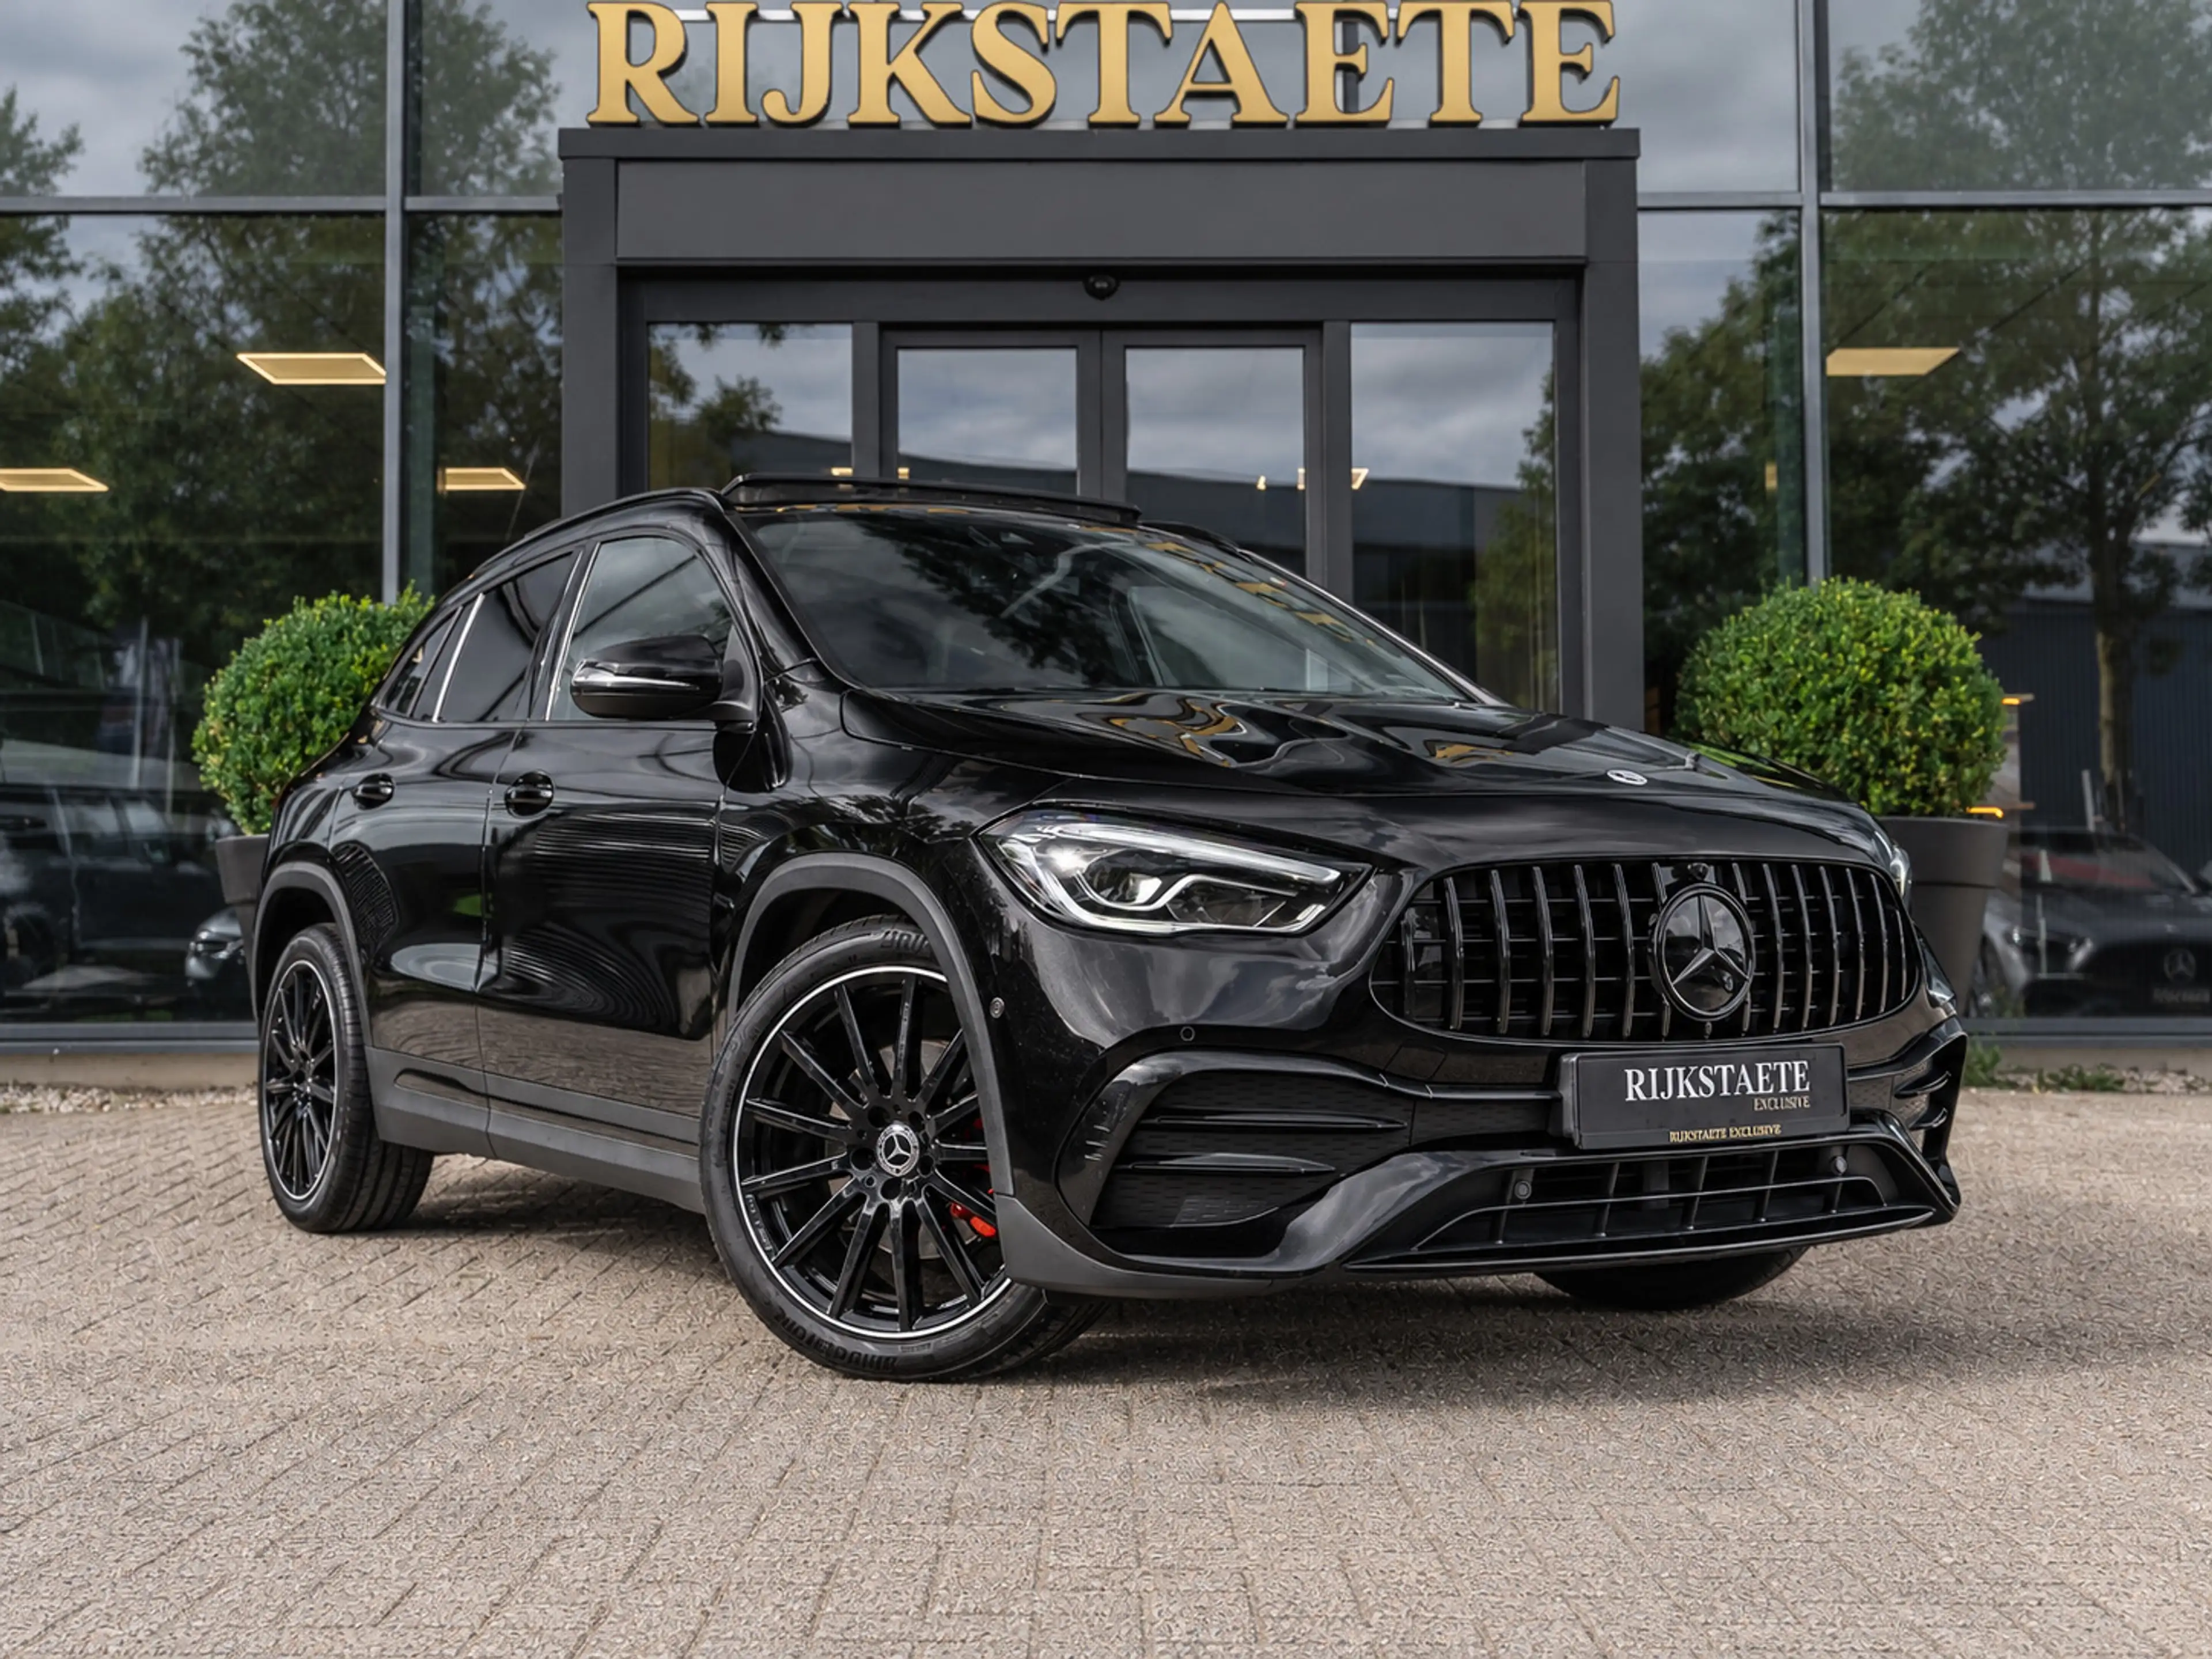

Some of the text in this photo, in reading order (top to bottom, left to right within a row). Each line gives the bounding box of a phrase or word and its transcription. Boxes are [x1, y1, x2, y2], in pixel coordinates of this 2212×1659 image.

[586, 1, 1620, 126] RIJKSTAETE
[1624, 1060, 1810, 1101] RIJKSTAETE
[1753, 1095, 1810, 1111] EXCLUSIVE
[1669, 1124, 1782, 1143] RIJKSTAETE EXCLUSIVE
